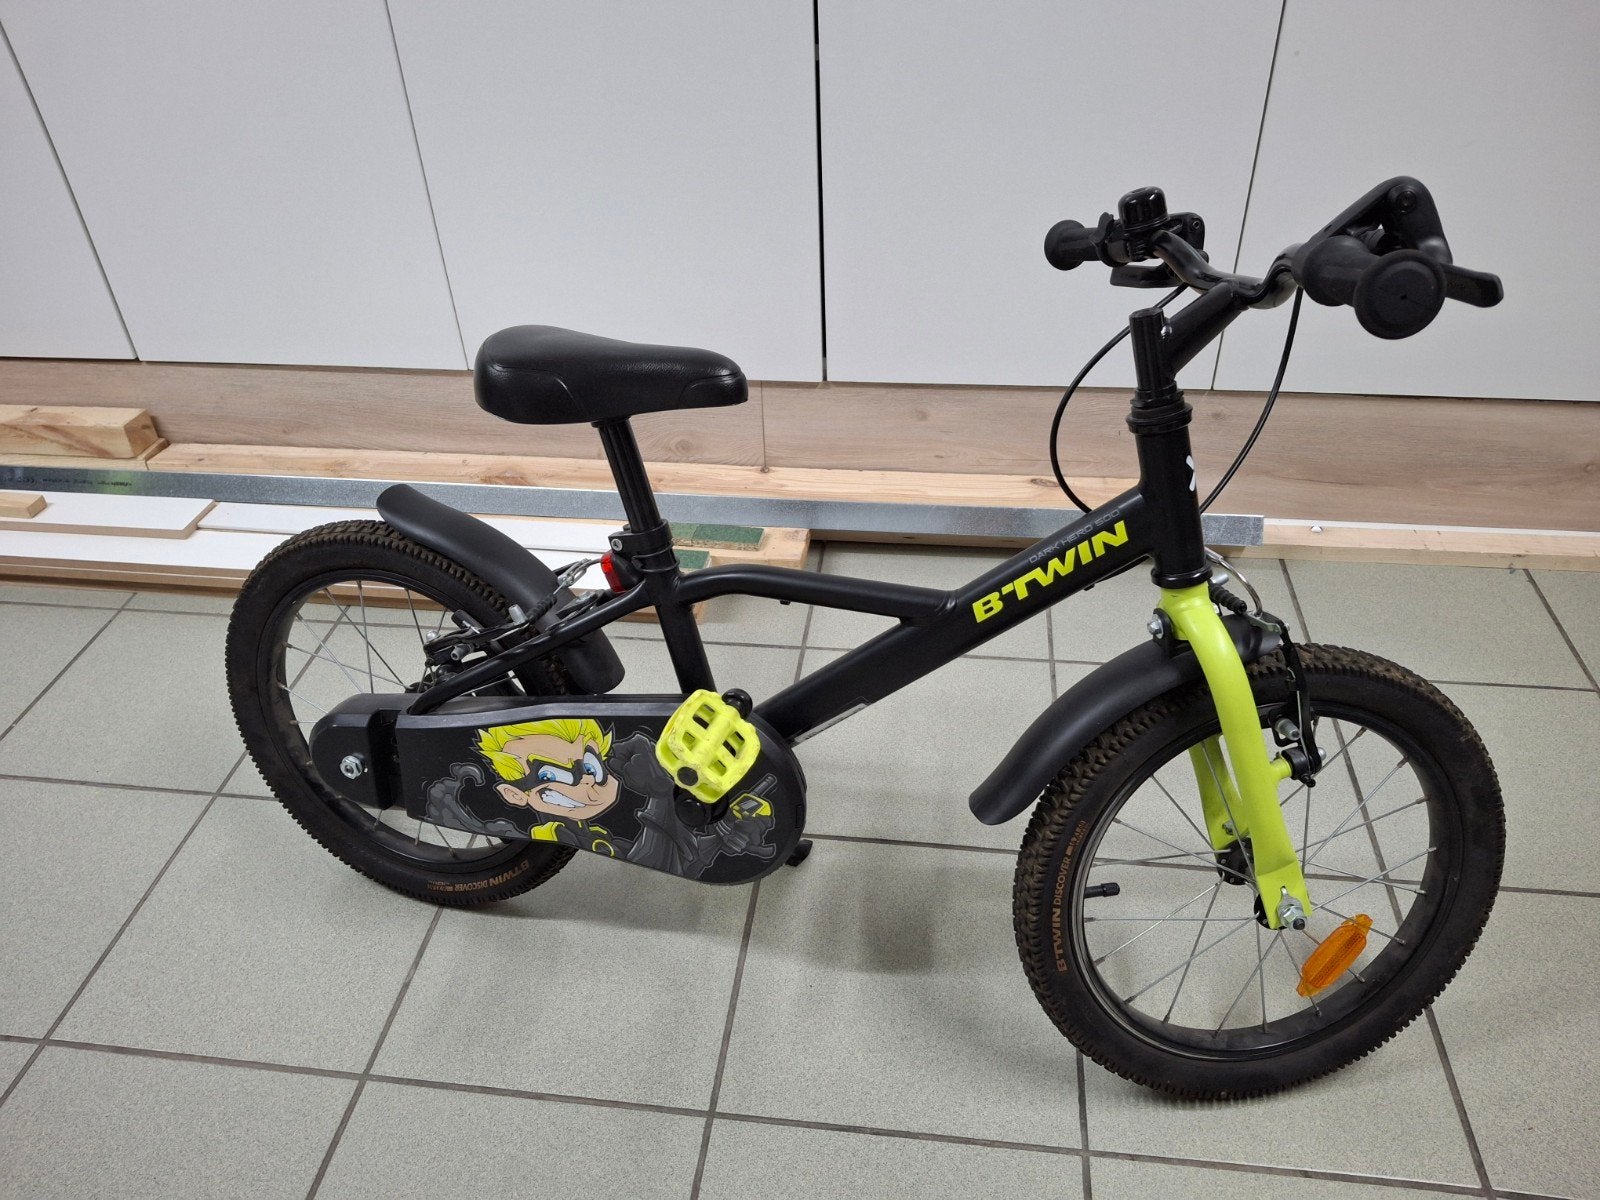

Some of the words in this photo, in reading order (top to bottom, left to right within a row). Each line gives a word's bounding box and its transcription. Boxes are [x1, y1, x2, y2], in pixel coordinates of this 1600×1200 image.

[1029, 542, 1063, 564] DARK
[1061, 525, 1093, 545] HERO
[1094, 509, 1120, 527] 500
[454, 880, 488, 892] DISCOVER
[1054, 856, 1072, 905] DISCOVER
